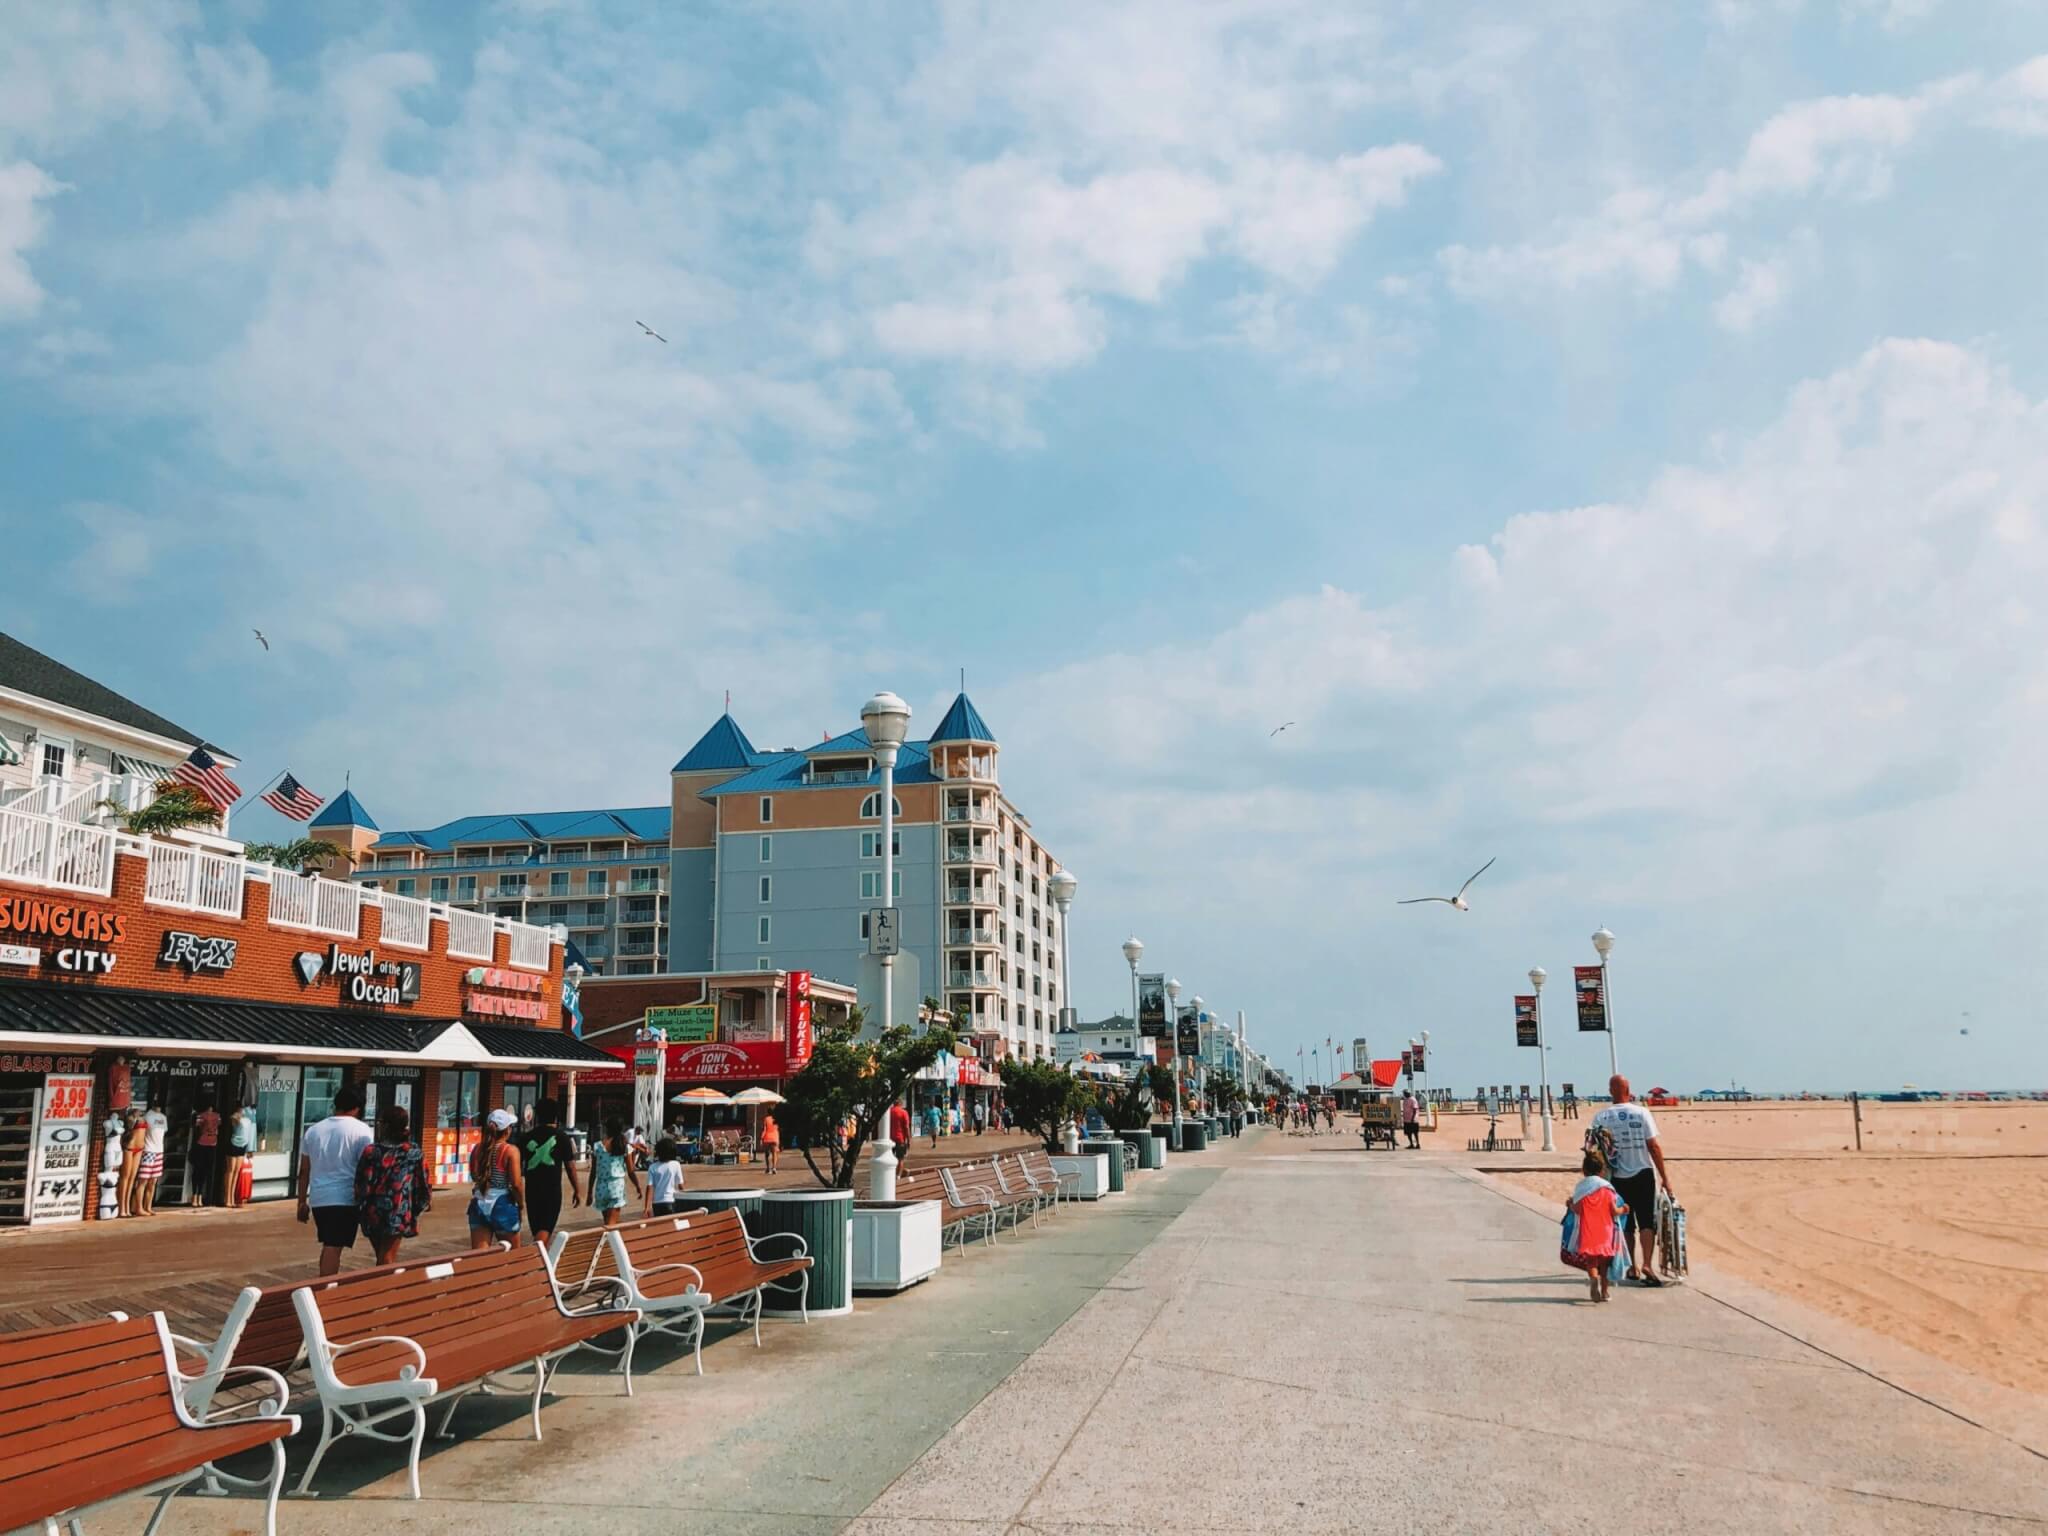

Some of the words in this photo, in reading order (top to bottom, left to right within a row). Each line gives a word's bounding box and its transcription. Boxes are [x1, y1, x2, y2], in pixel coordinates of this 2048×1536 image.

[0, 897, 127, 943] SUNGLASS
[57, 948, 117, 973] CITY
[164, 931, 237, 972] FOX
[330, 944, 374, 975] Jewel
[380, 961, 388, 973] of
[388, 962, 400, 976] the
[352, 976, 400, 1004] Ocean
[798, 973, 809, 1008] TOY
[471, 993, 549, 1020] KITCHEN
[57, 1056, 93, 1072] CITY
[701, 1052, 728, 1063] TONY
[161, 1063, 168, 1072] &
[200, 1063, 230, 1075] STORE
[696, 1064, 731, 1074] LUKE'S
[44, 1108, 51, 1119] 2
[53, 1108, 70, 1119] FOR
[44, 1159, 80, 1168] DEALER
[38, 1179, 82, 1199] FOX
